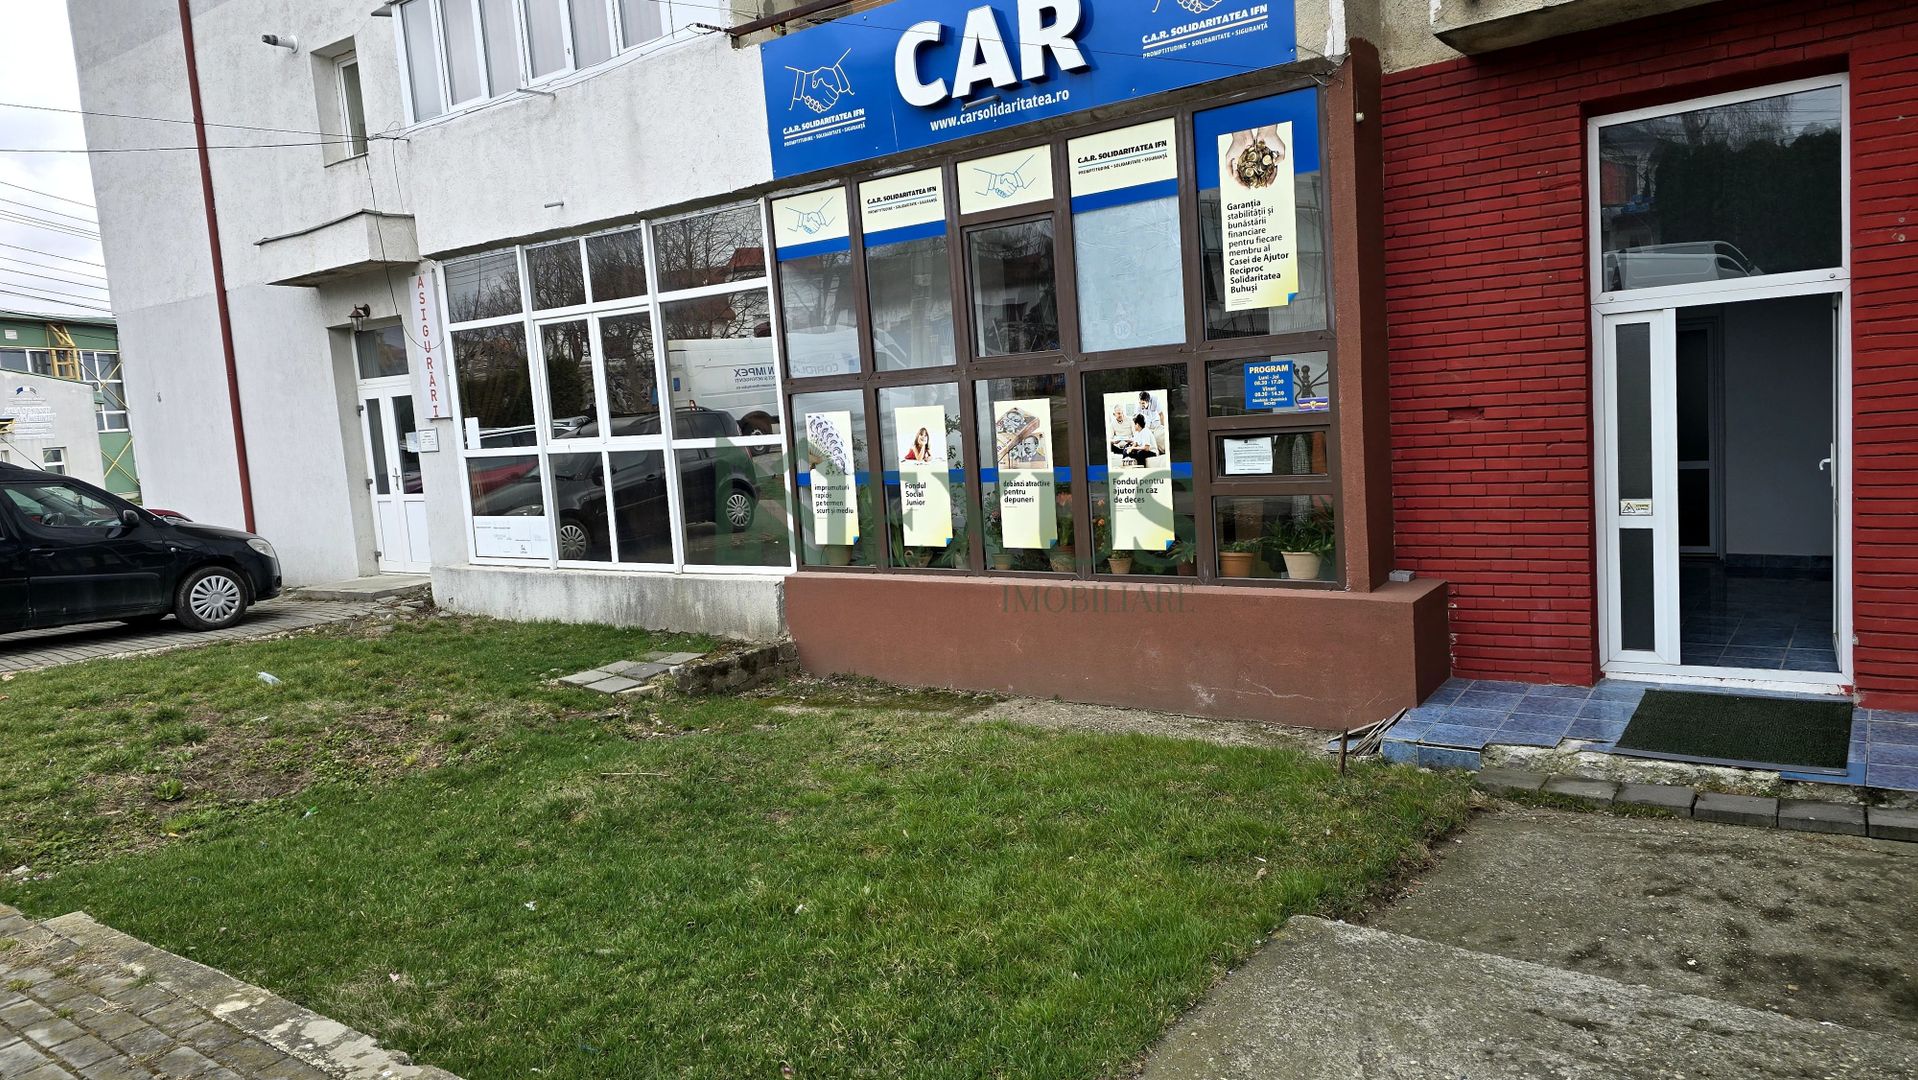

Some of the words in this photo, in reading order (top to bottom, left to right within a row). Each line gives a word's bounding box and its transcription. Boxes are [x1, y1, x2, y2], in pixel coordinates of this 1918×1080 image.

[1142, 30, 1169, 43] C.A.R.
[1170, 9, 1248, 36] SOLIDARITATEA
[1250, 4, 1268, 16] IFN
[1191, 32, 1230, 46] SOLIDARITATE
[894, 0, 1088, 107] CAR
[930, 89, 1069, 131] www.carsolidaritatea.ro
[783, 125, 801, 134] C.A.R.
[802, 112, 852, 130] SOLIDARITATEA
[853, 108, 864, 117] IFN
[1078, 154, 1097, 164] C.A.R.
[1098, 143, 1153, 160] SOLIDARITATEA
[1155, 140, 1167, 148] IFN
[883, 188, 926, 201] SOLIDARITATEA
[1227, 199, 1261, 210] Garanția
[1267, 206, 1274, 216] și
[1228, 227, 1266, 238] financiare
[1229, 238, 1254, 249] pentru
[1256, 234, 1282, 244] fiecare
[1229, 246, 1262, 256] membru
[1229, 256, 1250, 266] Casei
[1251, 255, 1261, 263] de
[1263, 252, 1289, 263] Ajutor
[1230, 264, 1264, 276] Reciproc
[1230, 272, 1281, 284] Solidaritatea
[417, 275, 438, 417] ASIGURĂRI
[1249, 364, 1288, 374] PROGRAM
[1112, 478, 1137, 486] Fondul
[1139, 477, 1164, 486] pentru
[1004, 488, 1026, 496] pentru
[1113, 487, 1135, 495] ajutor
[1004, 496, 1034, 504] depuneri
